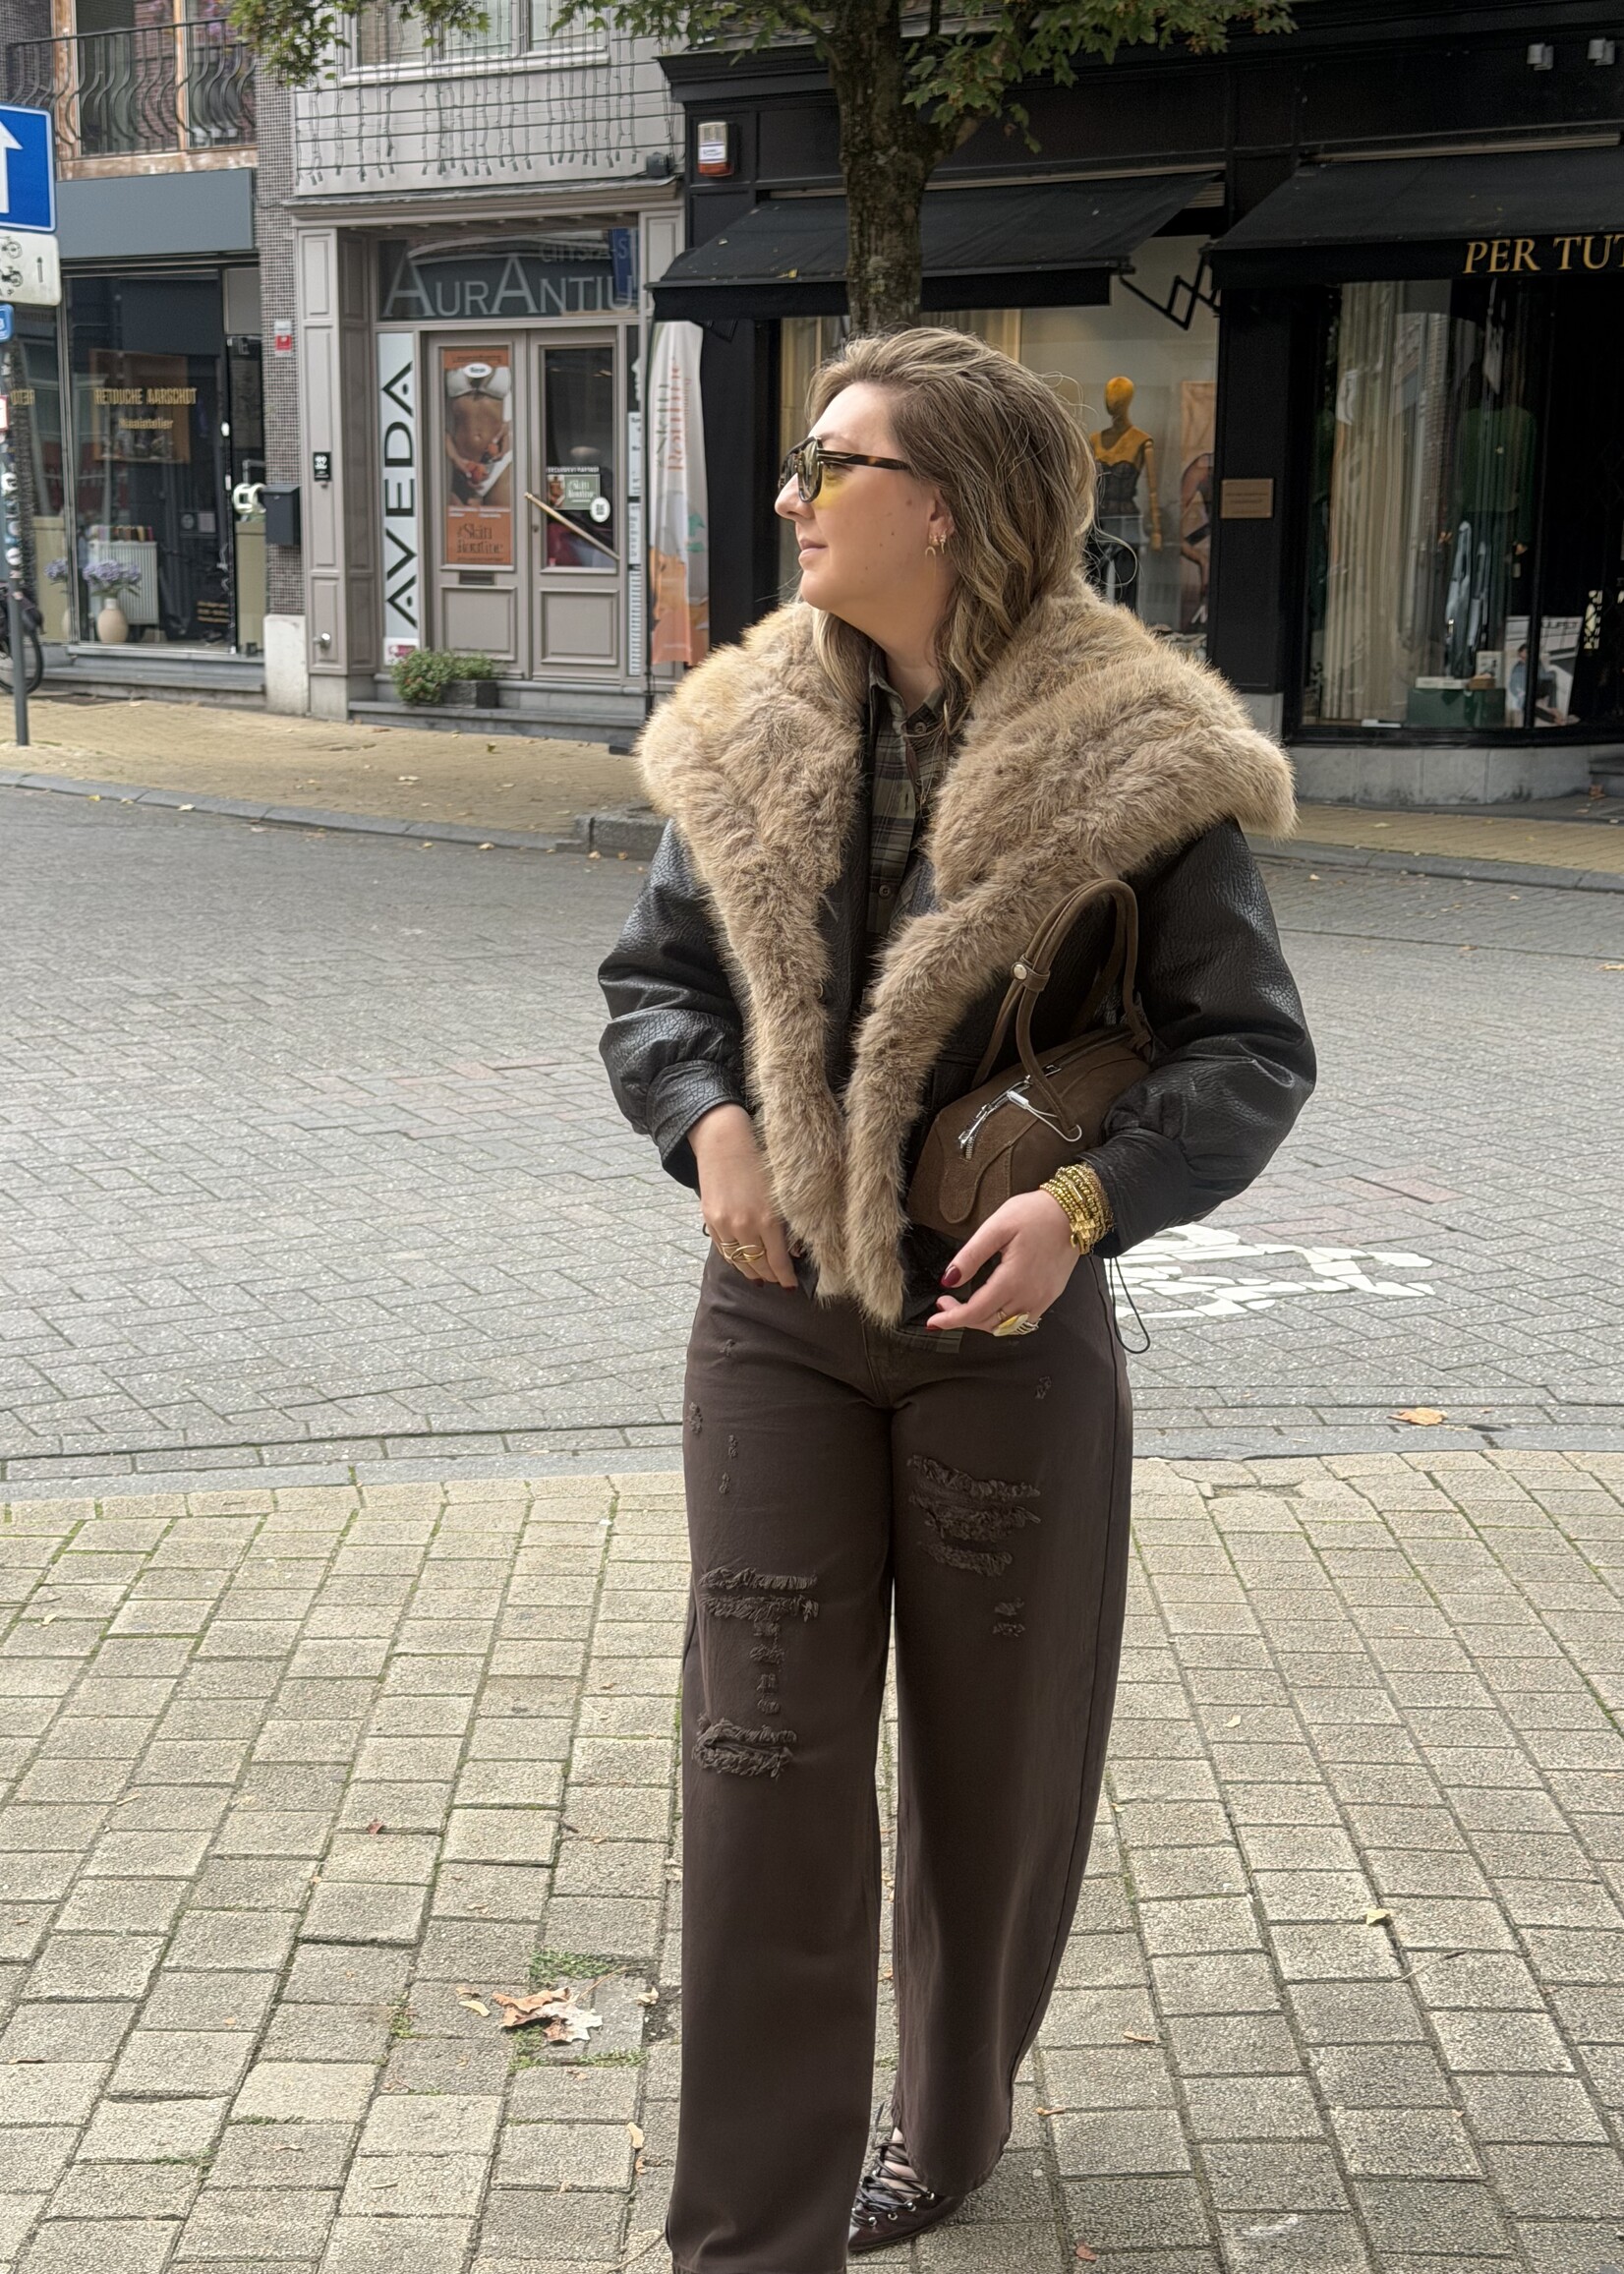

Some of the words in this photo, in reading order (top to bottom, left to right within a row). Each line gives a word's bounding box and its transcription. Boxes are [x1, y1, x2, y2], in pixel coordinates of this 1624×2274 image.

[1463, 238, 1541, 274] PER
[93, 387, 144, 405] RETOUCHE
[146, 387, 198, 405] AARSCHOT
[380, 361, 418, 629] AVEDA
